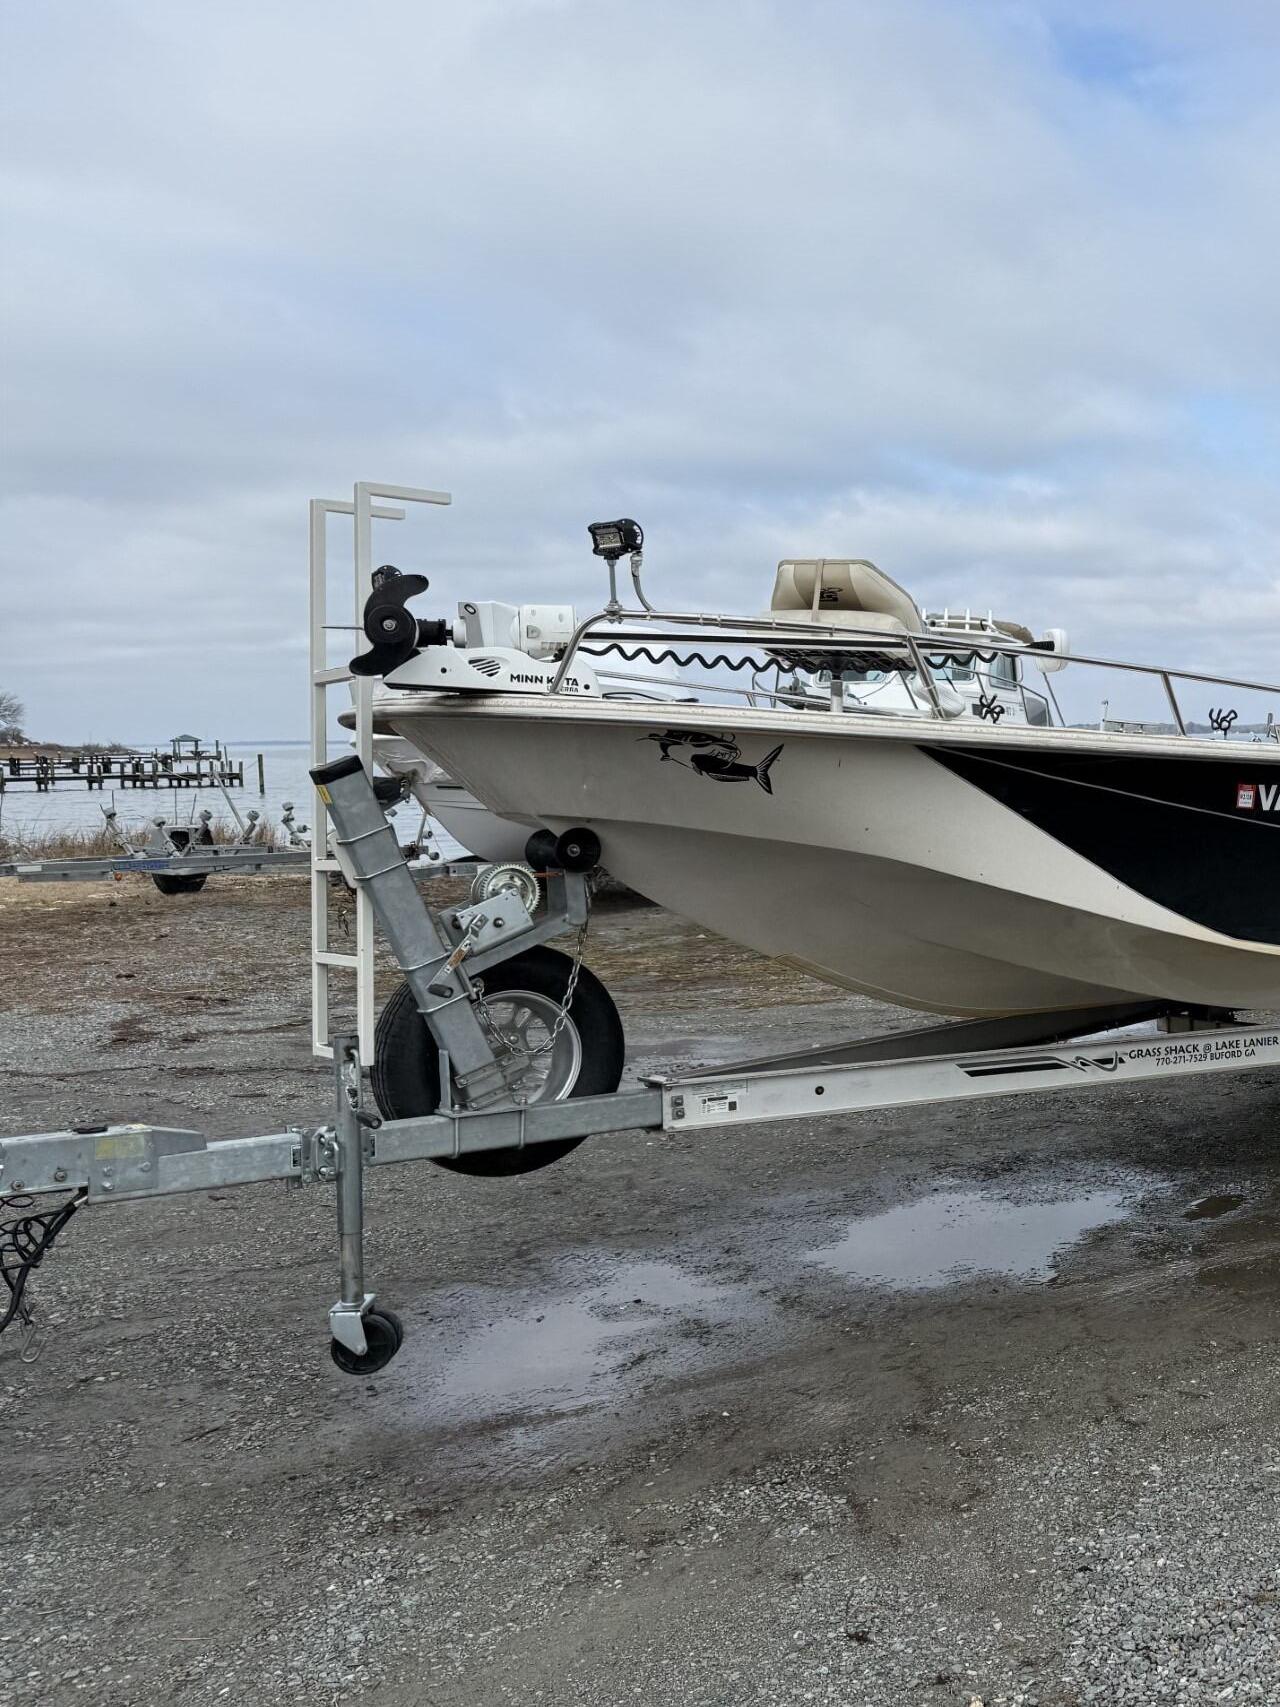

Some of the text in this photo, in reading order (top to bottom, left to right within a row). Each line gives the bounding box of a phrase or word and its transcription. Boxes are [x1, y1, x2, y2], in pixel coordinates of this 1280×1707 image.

[510, 673, 579, 686] MINN KTA
[1128, 1036, 1279, 1060] GRASS SHACK @ LAKE LANIER
[1156, 1048, 1256, 1067] 770-271-7529 BUFORD GA
